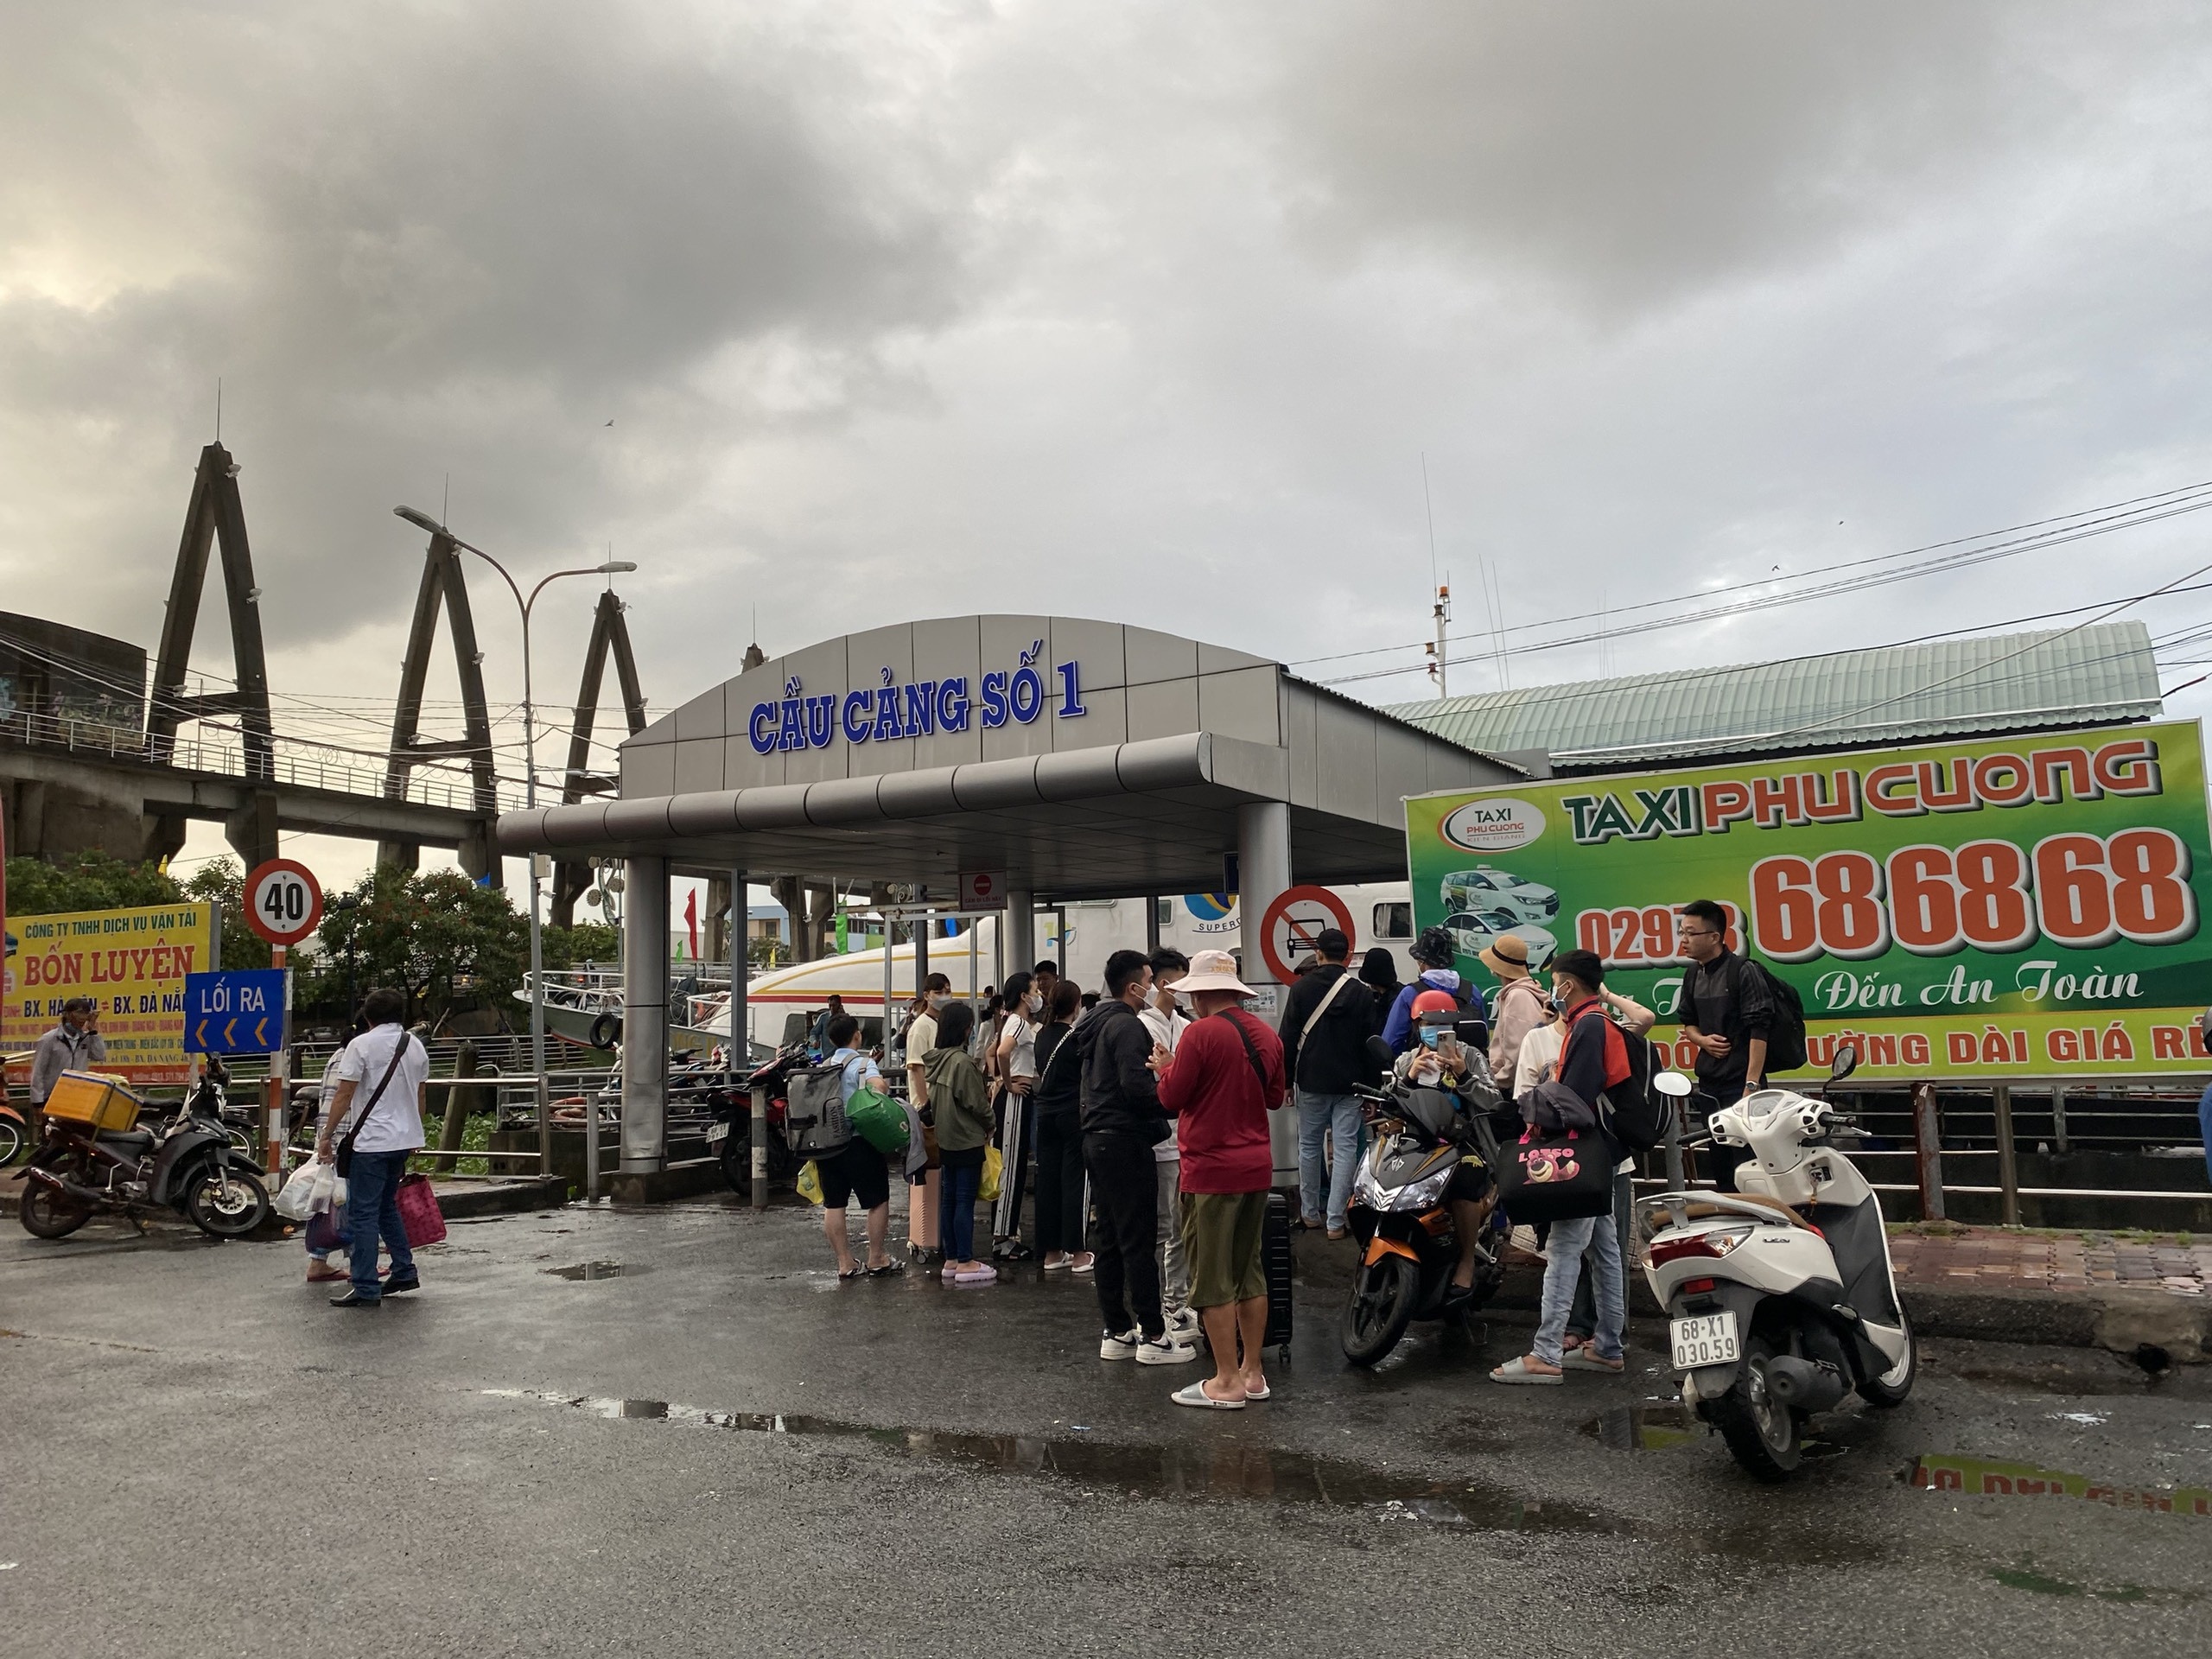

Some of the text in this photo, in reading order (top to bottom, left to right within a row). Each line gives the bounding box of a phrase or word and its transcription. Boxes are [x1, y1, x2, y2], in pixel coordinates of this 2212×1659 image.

[748, 639, 1086, 754] CẦU CẢNG SỐ 1
[1474, 808, 1511, 823] TAXI
[1564, 787, 1693, 840] TAXI
[1700, 770, 1854, 830] PHU
[1489, 823, 1524, 832] CUONG
[264, 883, 303, 920] 40
[25, 907, 196, 939] CÔNG TY TNHH DỊCH VỤ VẬN TẢI
[24, 941, 84, 987] BỐN
[91, 938, 195, 988] LUYỆN
[113, 996, 135, 1014] BX.
[140, 991, 158, 1014] ĐÀ
[201, 976, 265, 1013] LỐI RA
[1815, 959, 2145, 1010] Đến An Toàn
[24, 1000, 44, 1018] BX.
[1807, 1031, 1930, 1066] ƯỜNG
[1948, 1026, 2030, 1064] DÀI
[2047, 1021, 2133, 1061] GIÁ
[1677, 1338, 1734, 1365] 030.59
